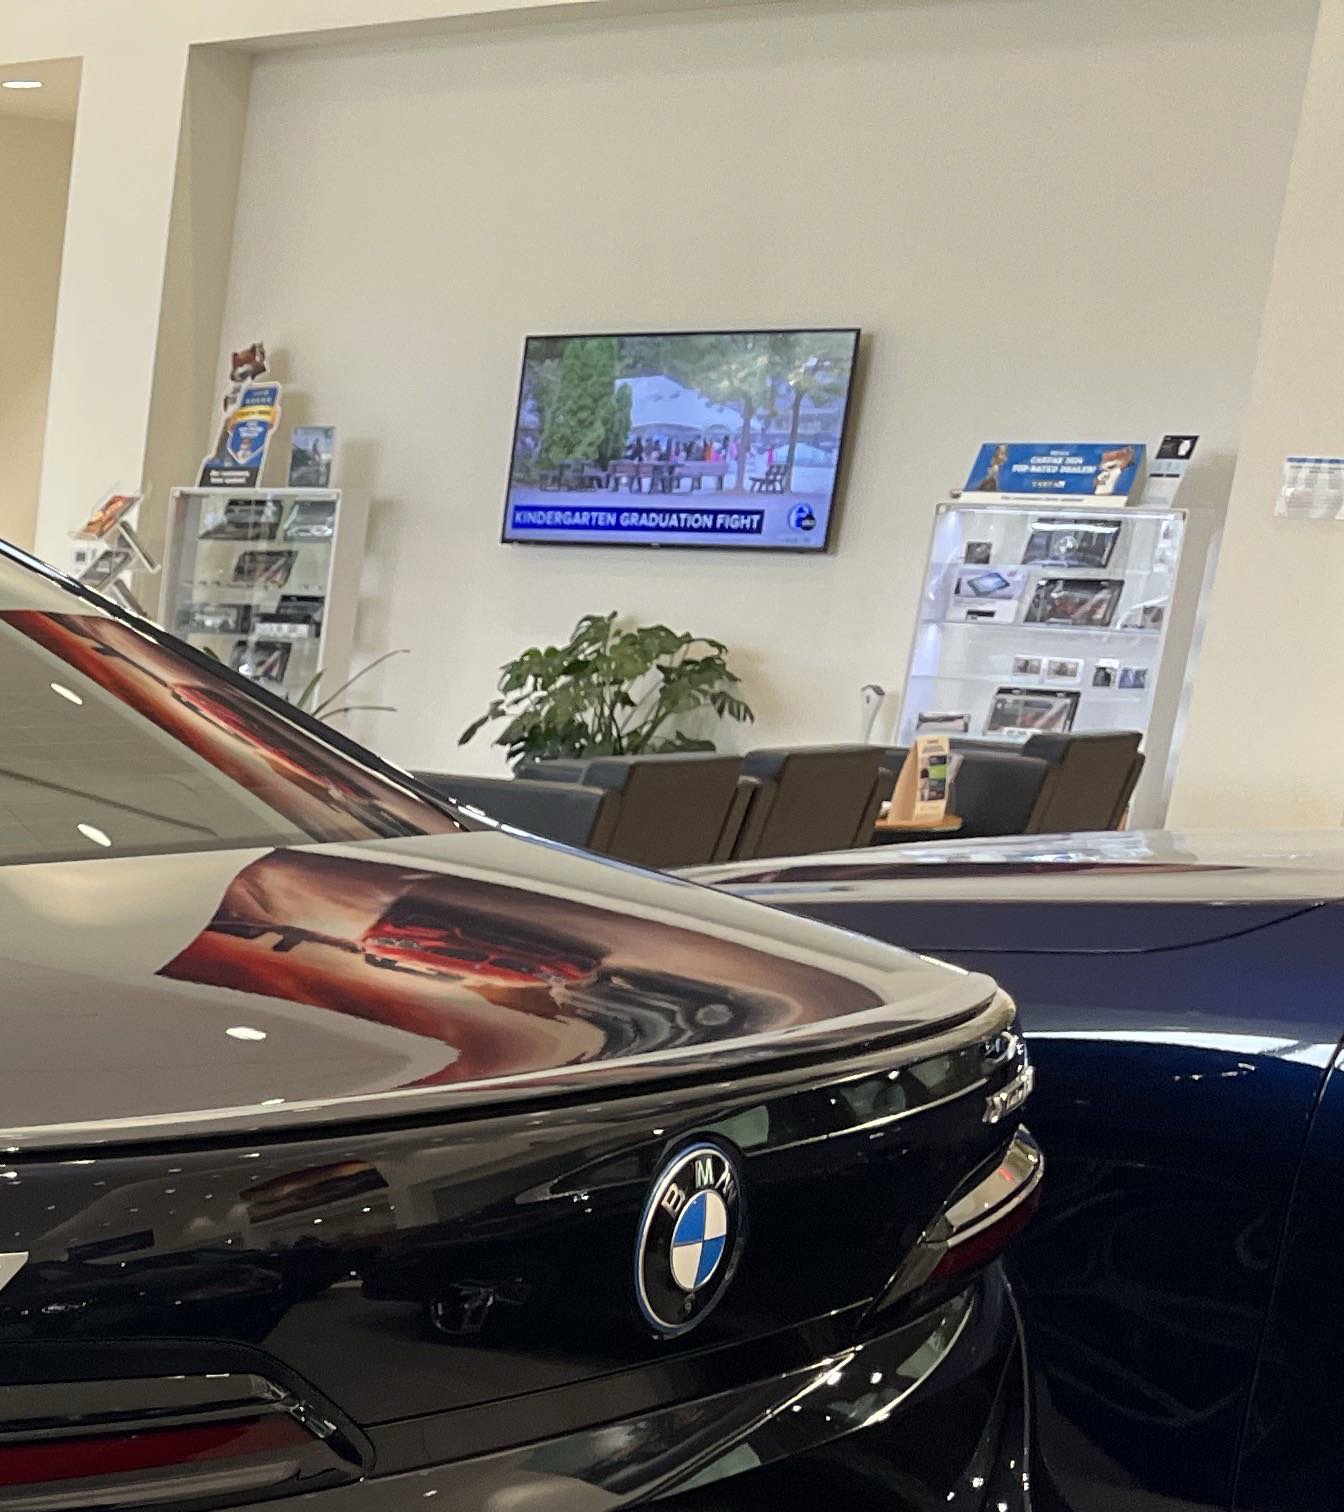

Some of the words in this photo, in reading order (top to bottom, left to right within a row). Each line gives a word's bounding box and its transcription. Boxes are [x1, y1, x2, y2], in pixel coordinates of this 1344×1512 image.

[513, 511, 616, 527] KINDERGARTEN
[619, 513, 713, 530] GRADUATION
[715, 515, 760, 530] FIGHT
